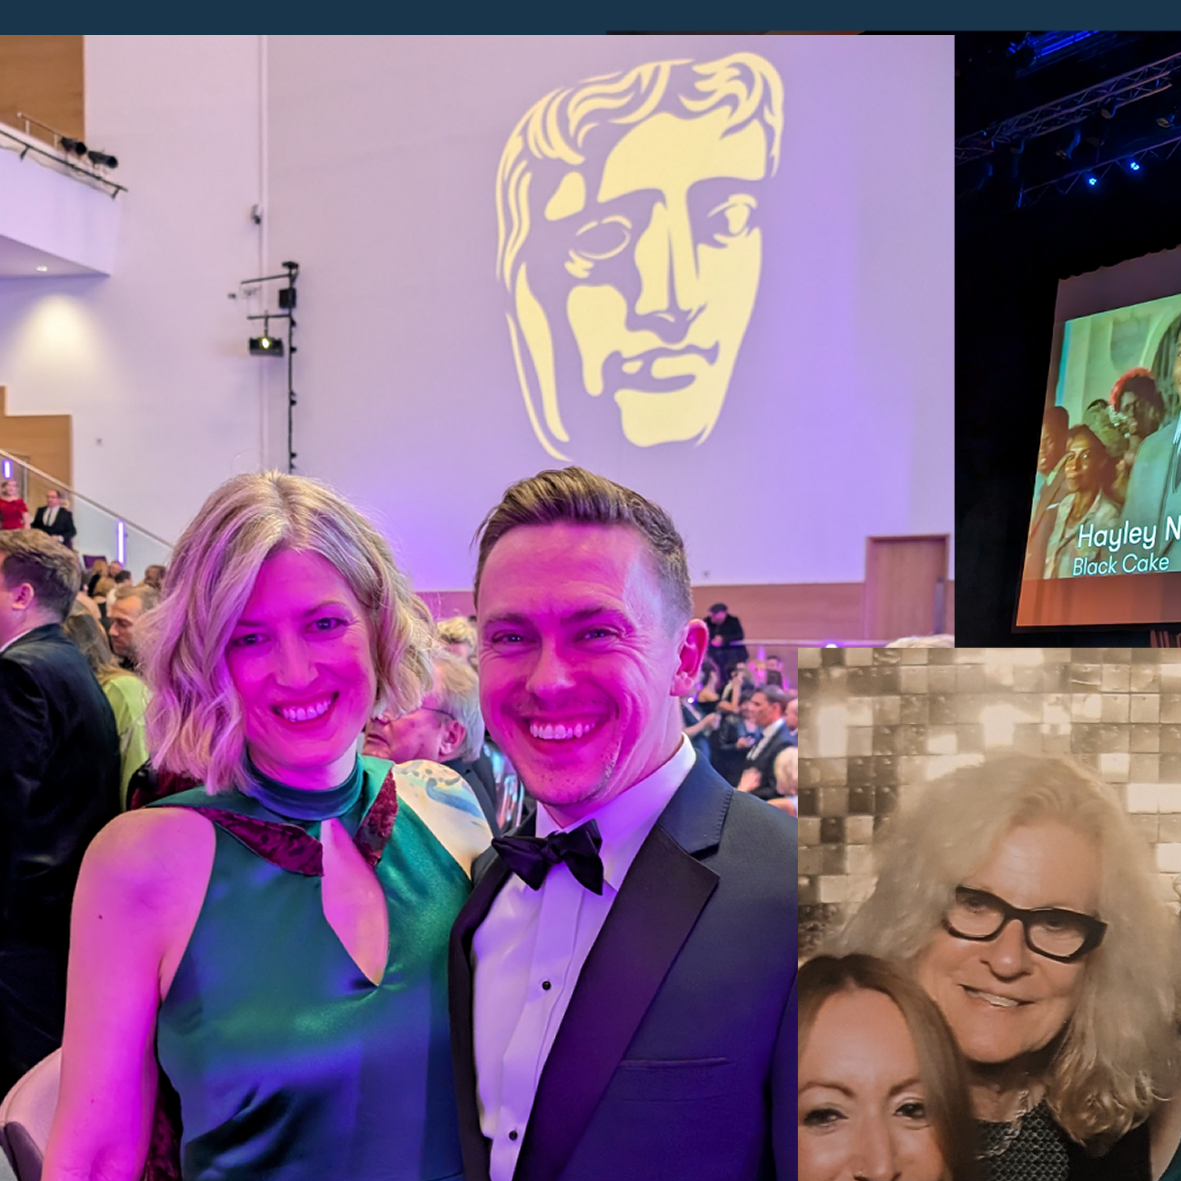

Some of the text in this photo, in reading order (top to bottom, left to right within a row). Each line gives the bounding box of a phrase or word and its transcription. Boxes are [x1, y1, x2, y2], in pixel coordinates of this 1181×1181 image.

[1078, 520, 1156, 552] Hayley
[1073, 552, 1170, 576] Black Cake
